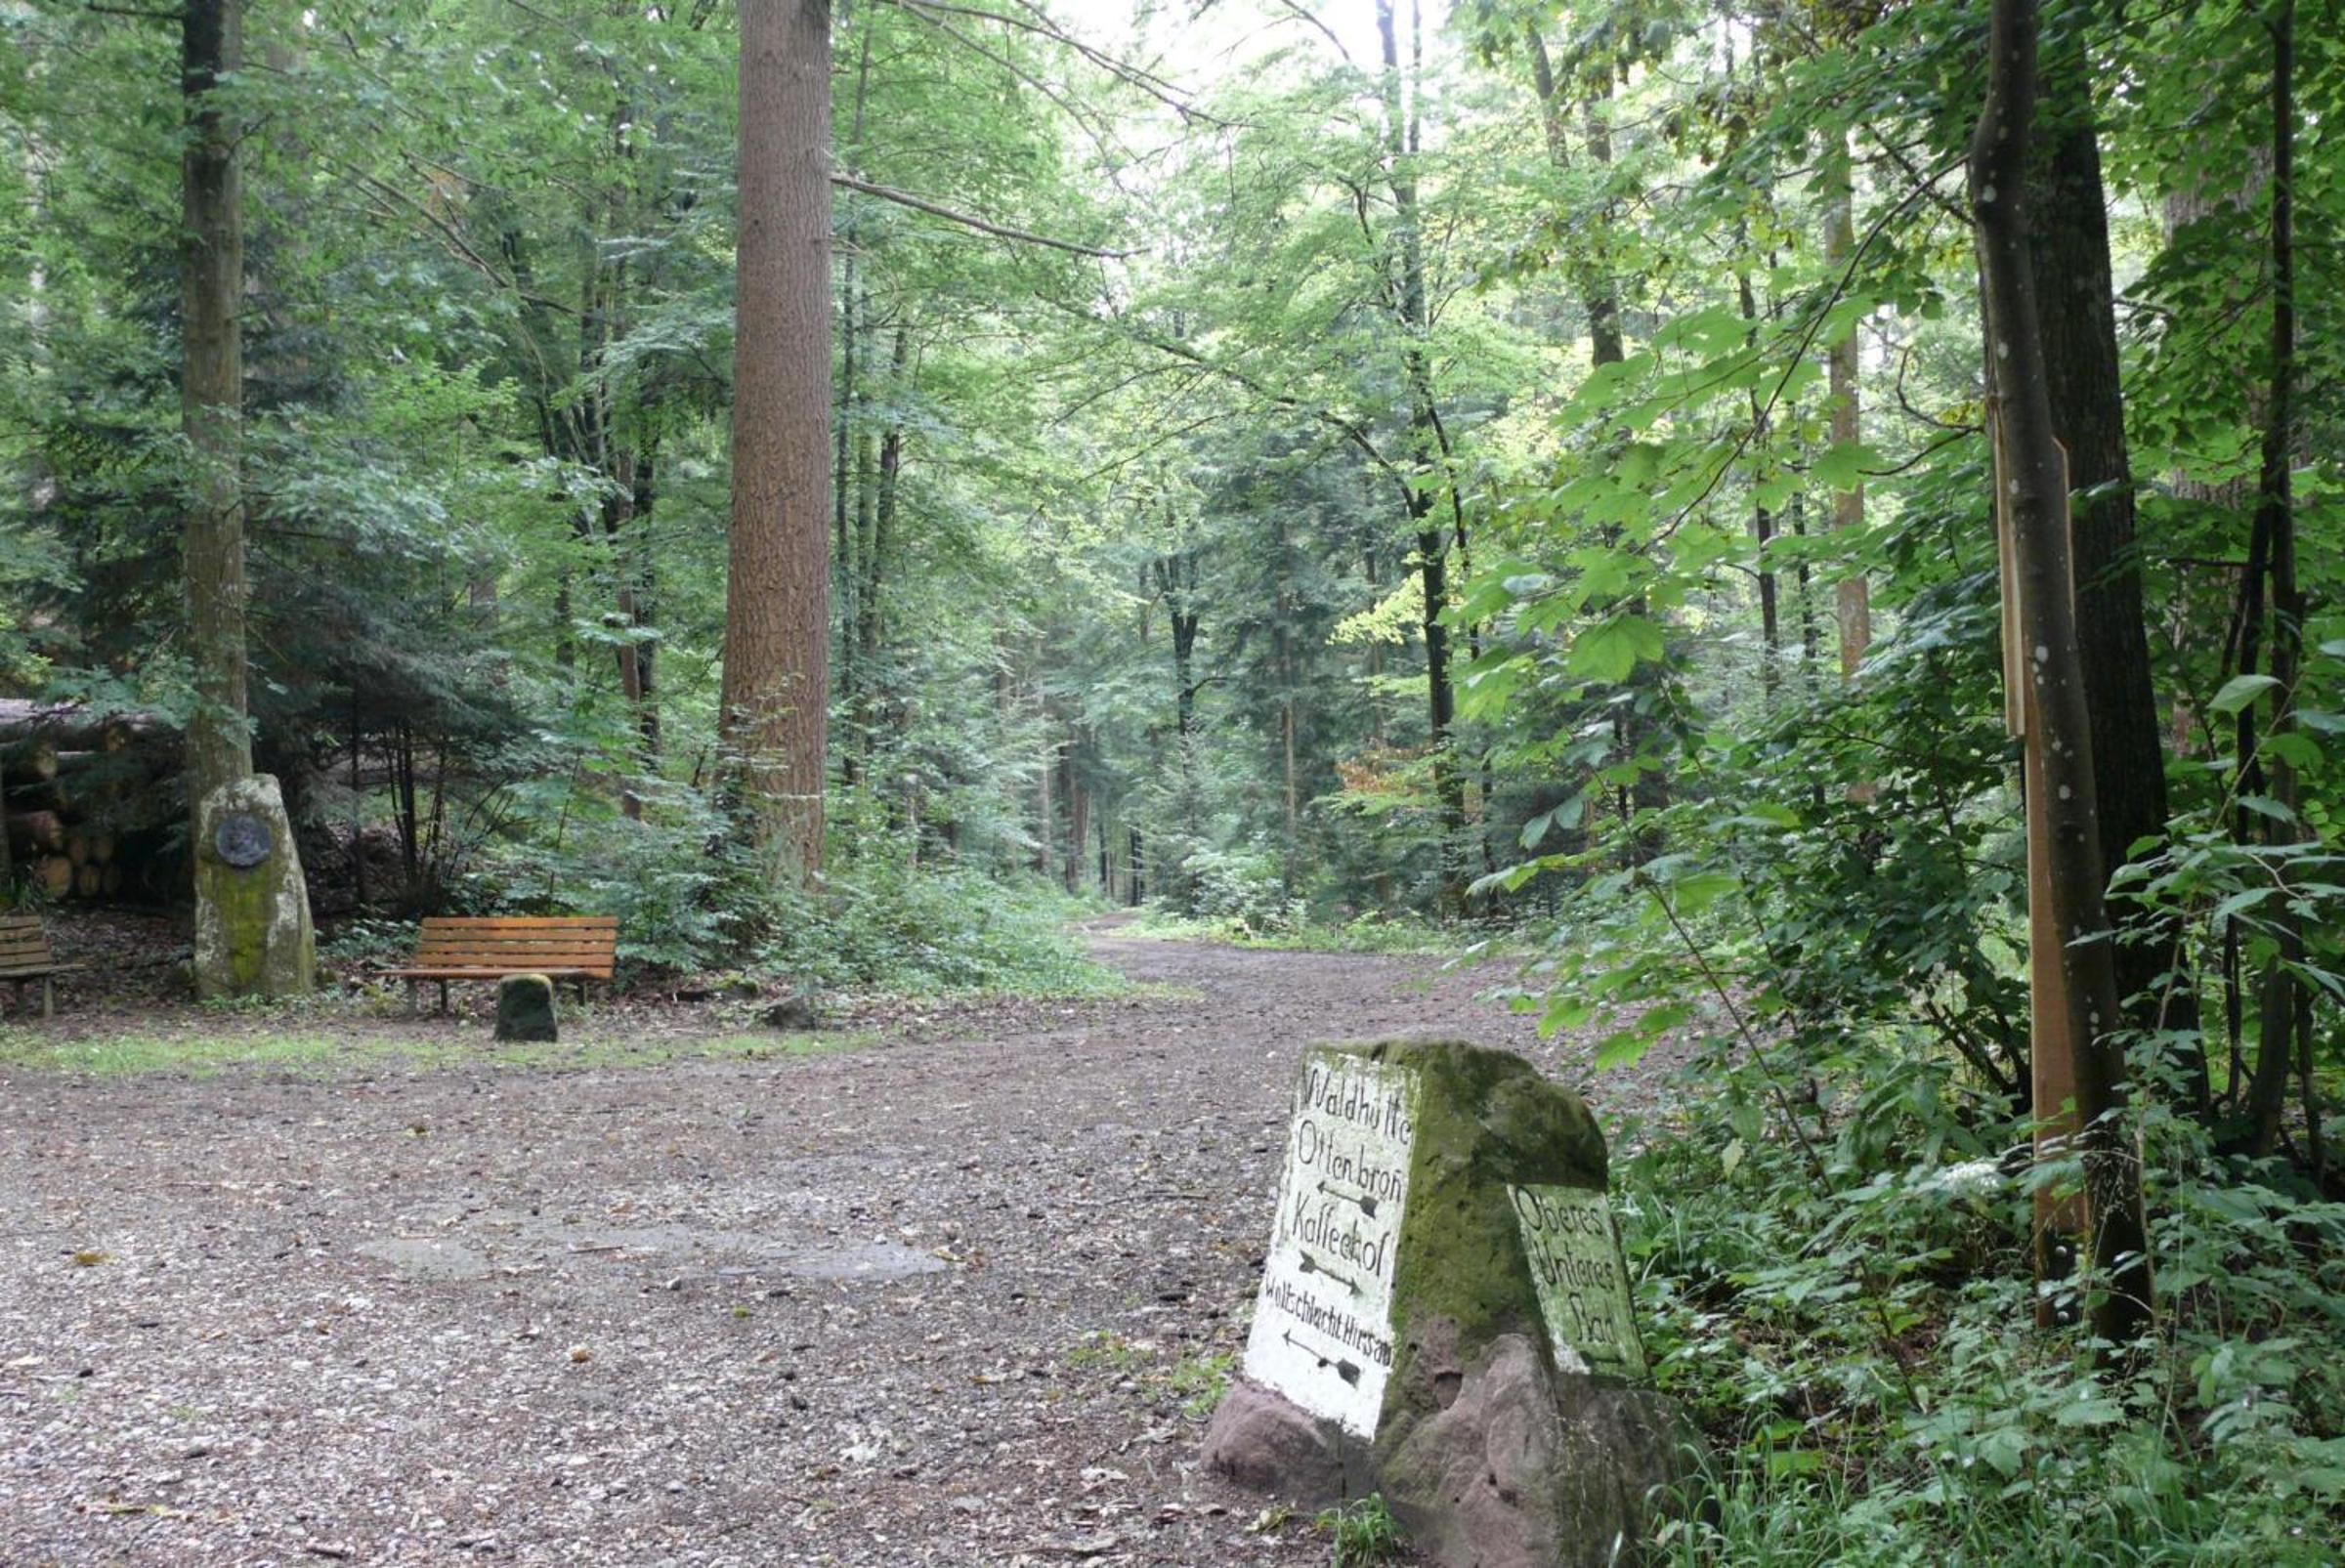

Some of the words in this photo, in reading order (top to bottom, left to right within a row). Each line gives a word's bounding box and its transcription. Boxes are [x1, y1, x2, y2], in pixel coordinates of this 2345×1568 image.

[1292, 1191, 1390, 1277] Kaffeehof
[1515, 1186, 1603, 1236] Oberes
[1532, 1241, 1616, 1291] Unteres
